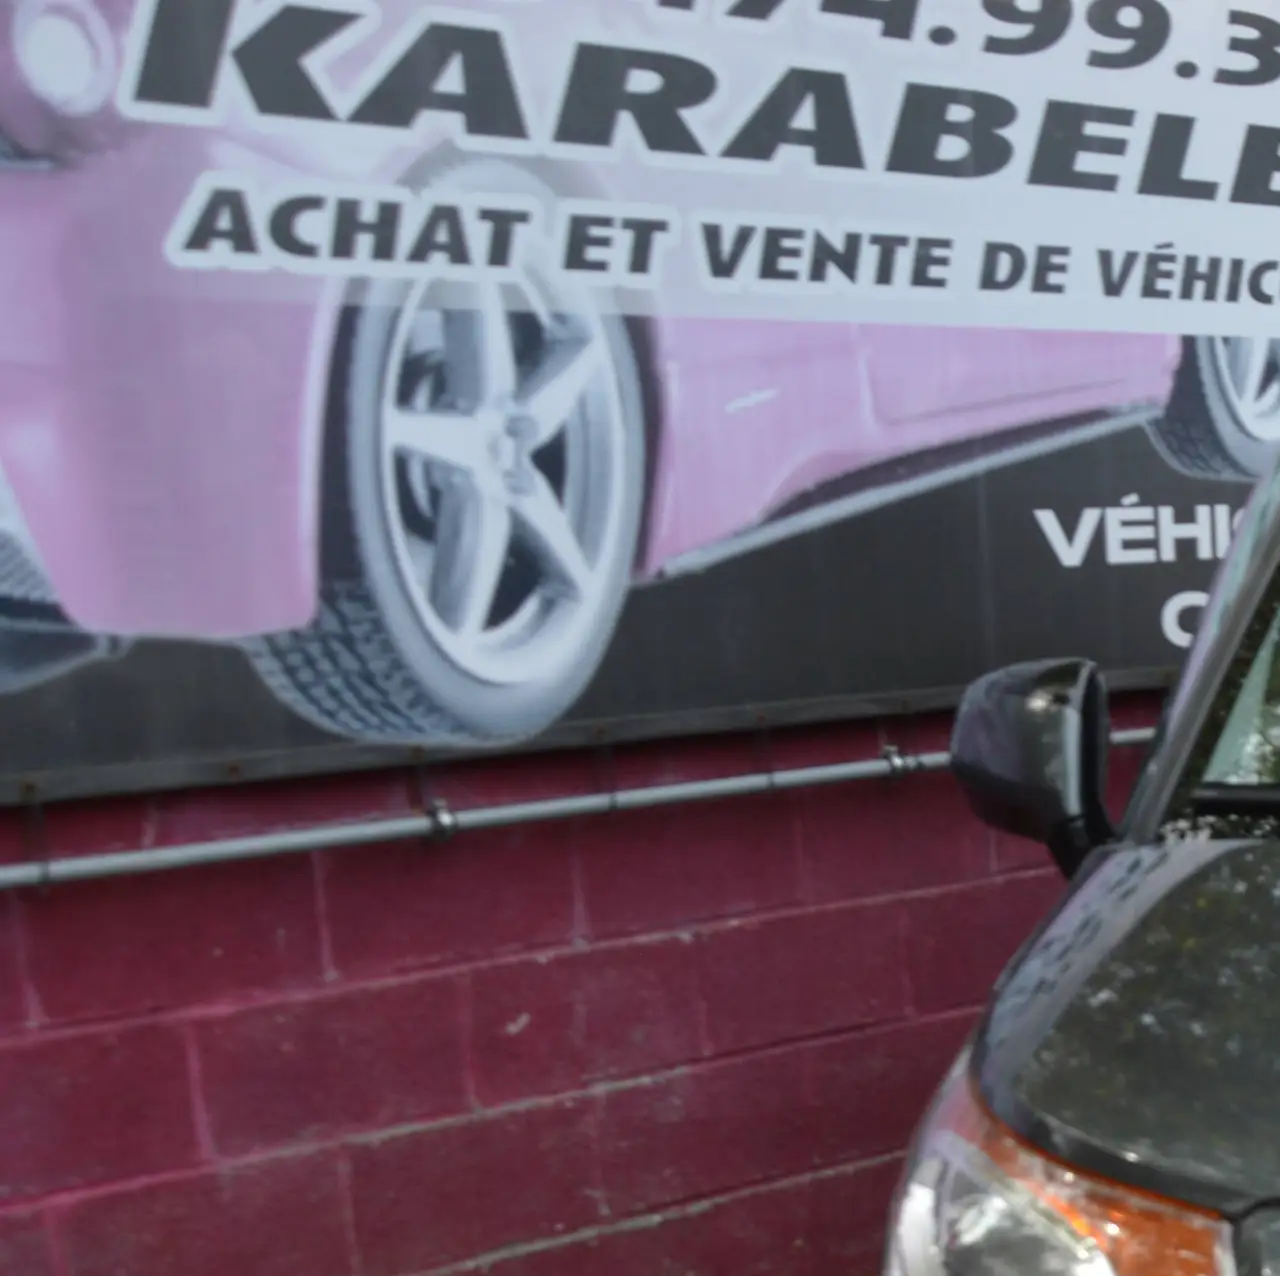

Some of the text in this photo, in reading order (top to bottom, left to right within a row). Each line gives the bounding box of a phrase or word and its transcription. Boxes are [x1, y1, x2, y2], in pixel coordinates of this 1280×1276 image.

[184, 187, 532, 267] ACHAT
[563, 215, 668, 275] ET
[702, 222, 954, 288] VENTE
[978, 241, 1071, 295] DE
